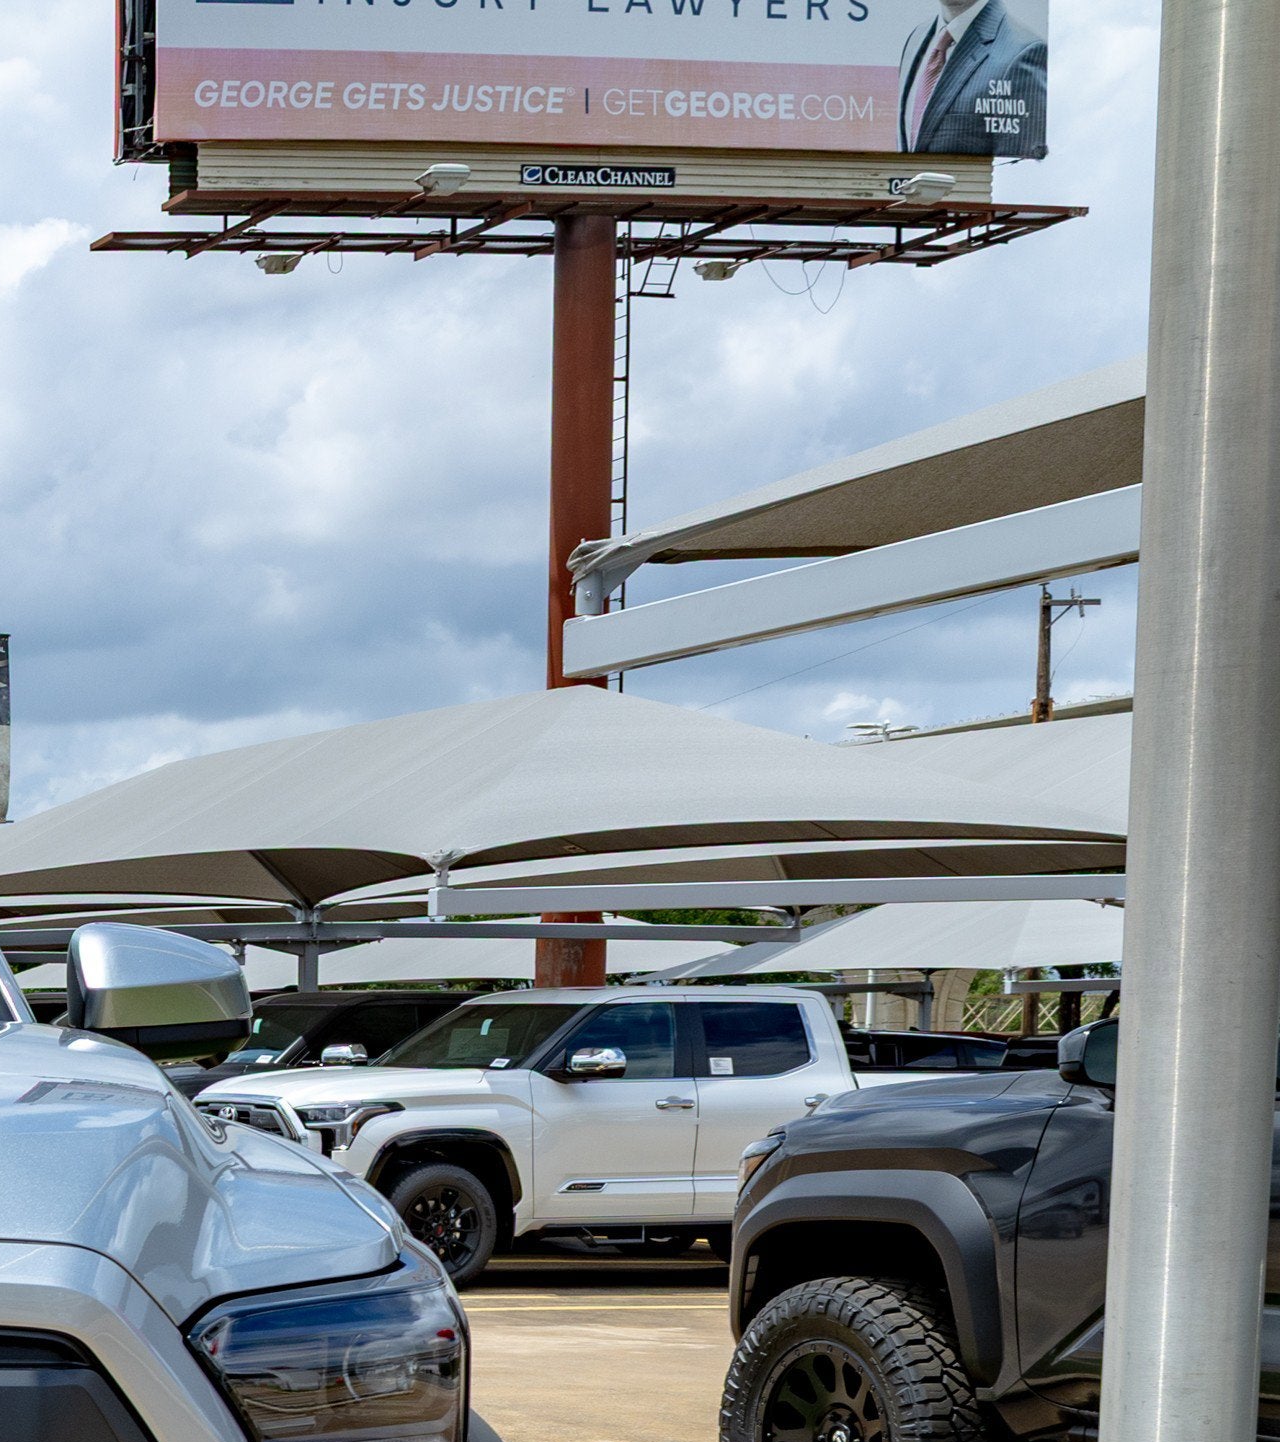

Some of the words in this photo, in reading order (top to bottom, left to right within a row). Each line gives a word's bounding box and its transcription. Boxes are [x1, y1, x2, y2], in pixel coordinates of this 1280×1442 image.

[988, 79, 1012, 96] SAN
[194, 80, 334, 109] GEORGE
[342, 82, 427, 110] GETS
[603, 88, 874, 122] GETGEORGE.COM
[974, 97, 1030, 118] ANTONIO,
[983, 116, 1020, 134] TEXAS
